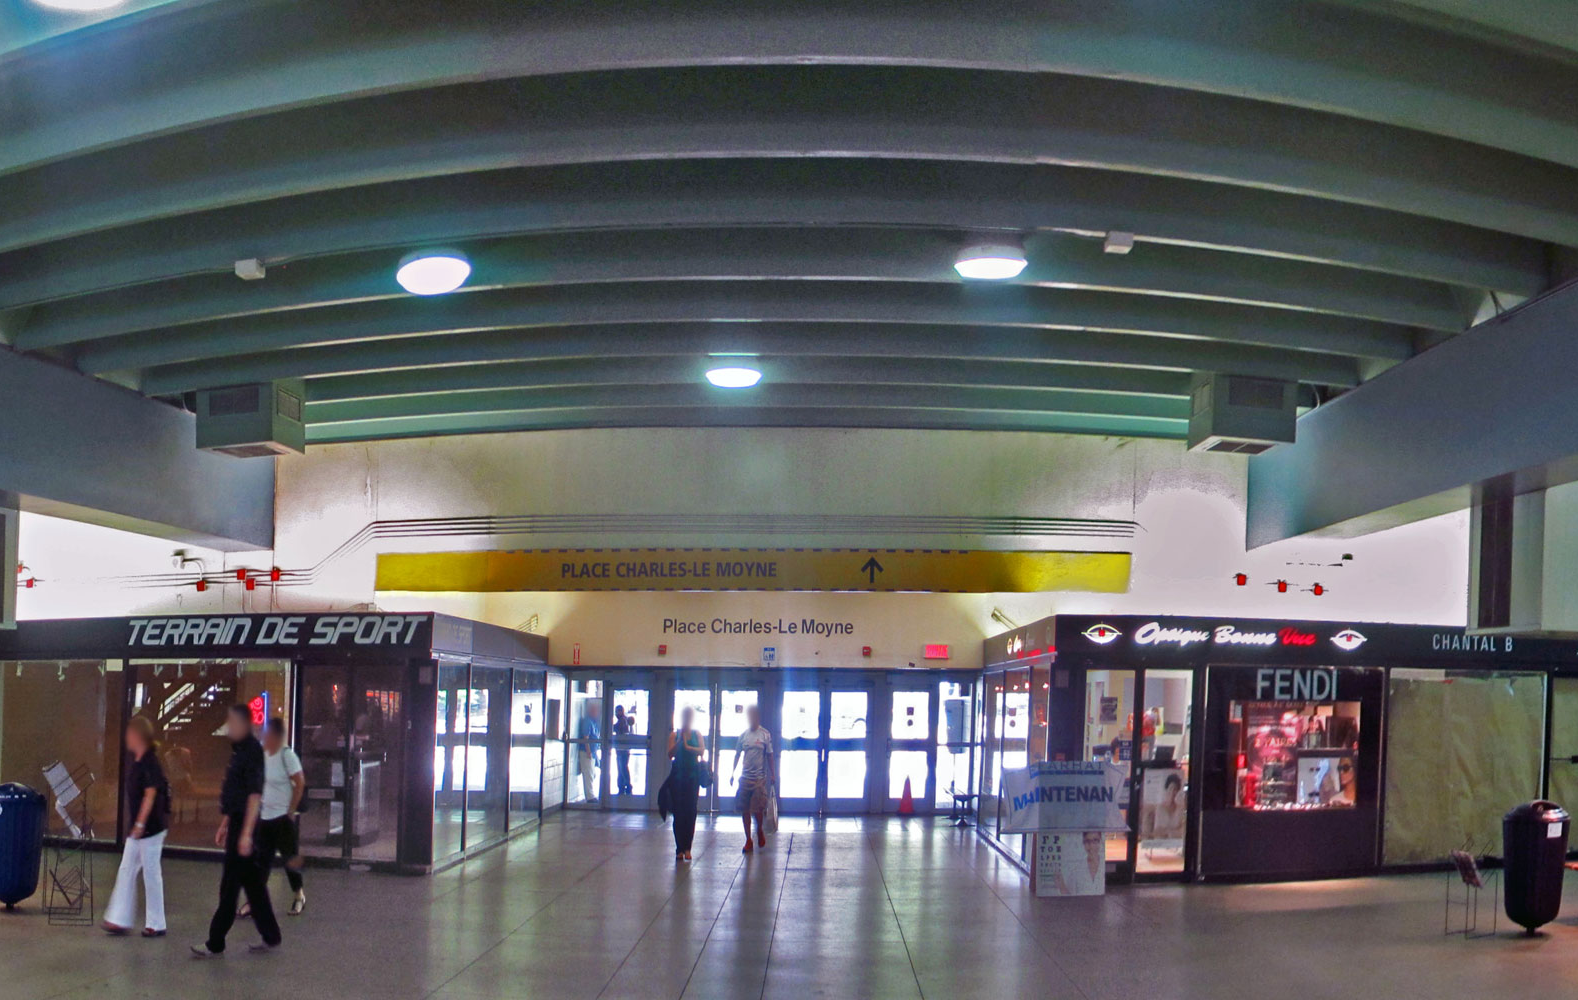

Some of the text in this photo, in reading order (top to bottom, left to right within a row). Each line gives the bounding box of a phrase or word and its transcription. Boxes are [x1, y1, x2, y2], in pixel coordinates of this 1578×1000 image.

[561, 561, 777, 579] PLACE CHARLES-LE MOYNE
[128, 617, 252, 646] TERRAIN
[256, 616, 306, 645] DE
[309, 615, 428, 645] SPORT
[662, 618, 854, 637] Place Charles-Le Moyne
[1134, 622, 1211, 647] Optique
[1432, 633, 1513, 652] CHANTAL B
[1256, 667, 1337, 701] FENDI
